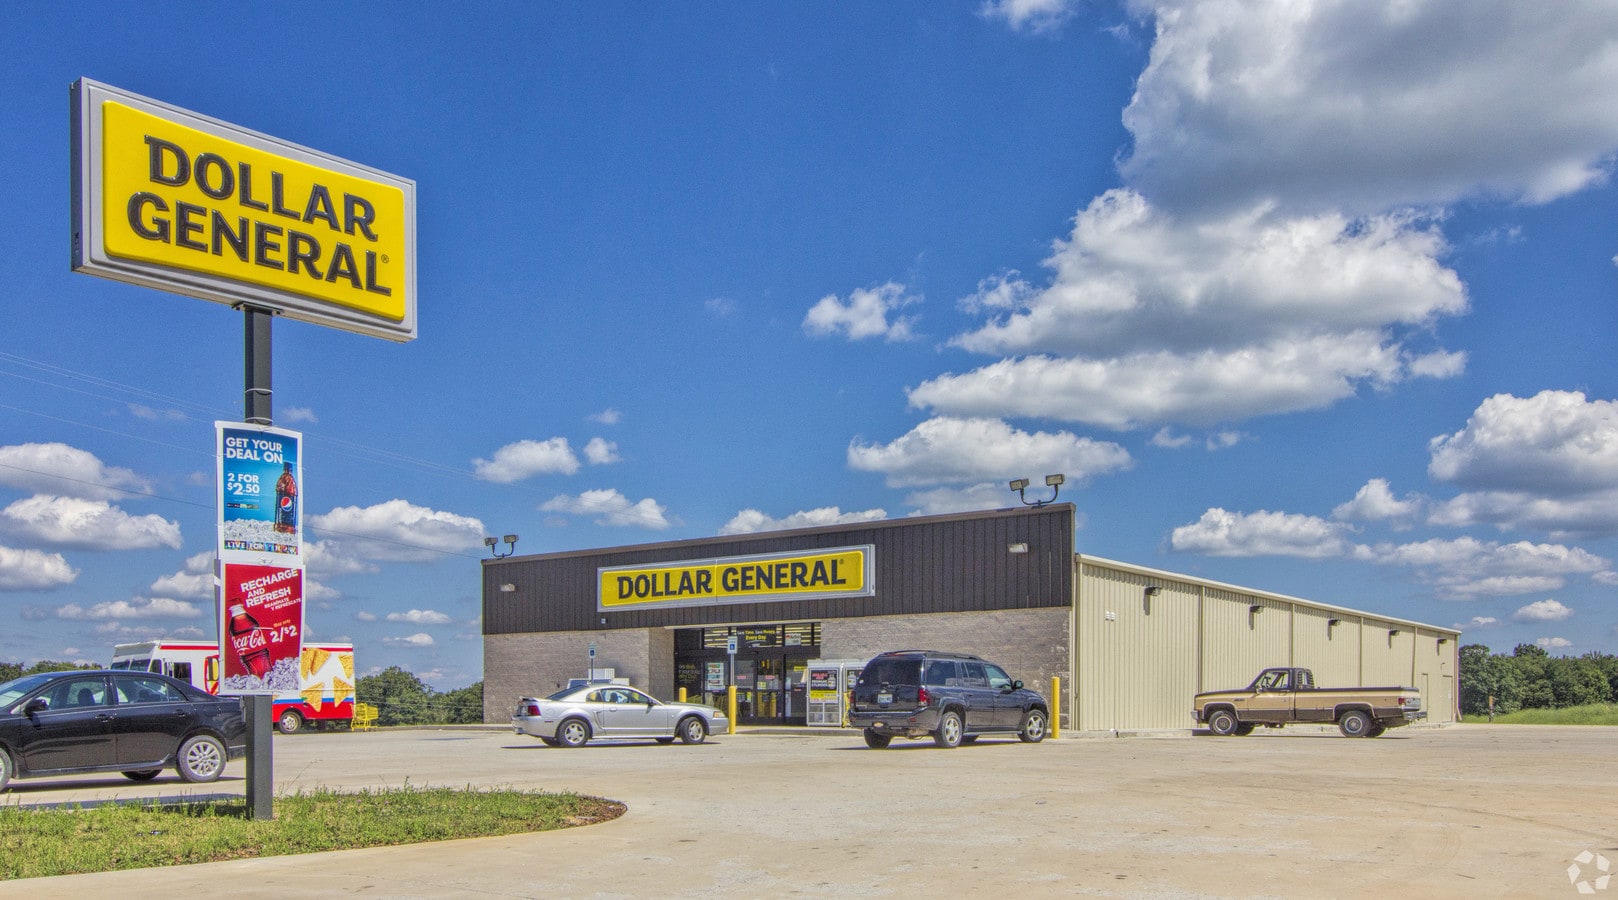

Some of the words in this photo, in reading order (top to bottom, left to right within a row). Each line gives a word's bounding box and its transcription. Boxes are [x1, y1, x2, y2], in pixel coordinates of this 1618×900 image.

[144, 134, 378, 242] DOLLAR
[226, 437, 248, 448] GET
[252, 439, 283, 453] YOUR
[226, 448, 260, 460] DEAL
[263, 451, 283, 464] ON
[227, 472, 235, 482] 2
[238, 473, 260, 484] FOR
[227, 482, 259, 495] $2.50
[227, 541, 246, 550] LIVE
[240, 569, 298, 592] RECHARGE
[616, 569, 713, 600] DOLLAR
[245, 587, 291, 608] REFRESH
[247, 588, 266, 598] AND
[270, 625, 298, 643] 2/$2
